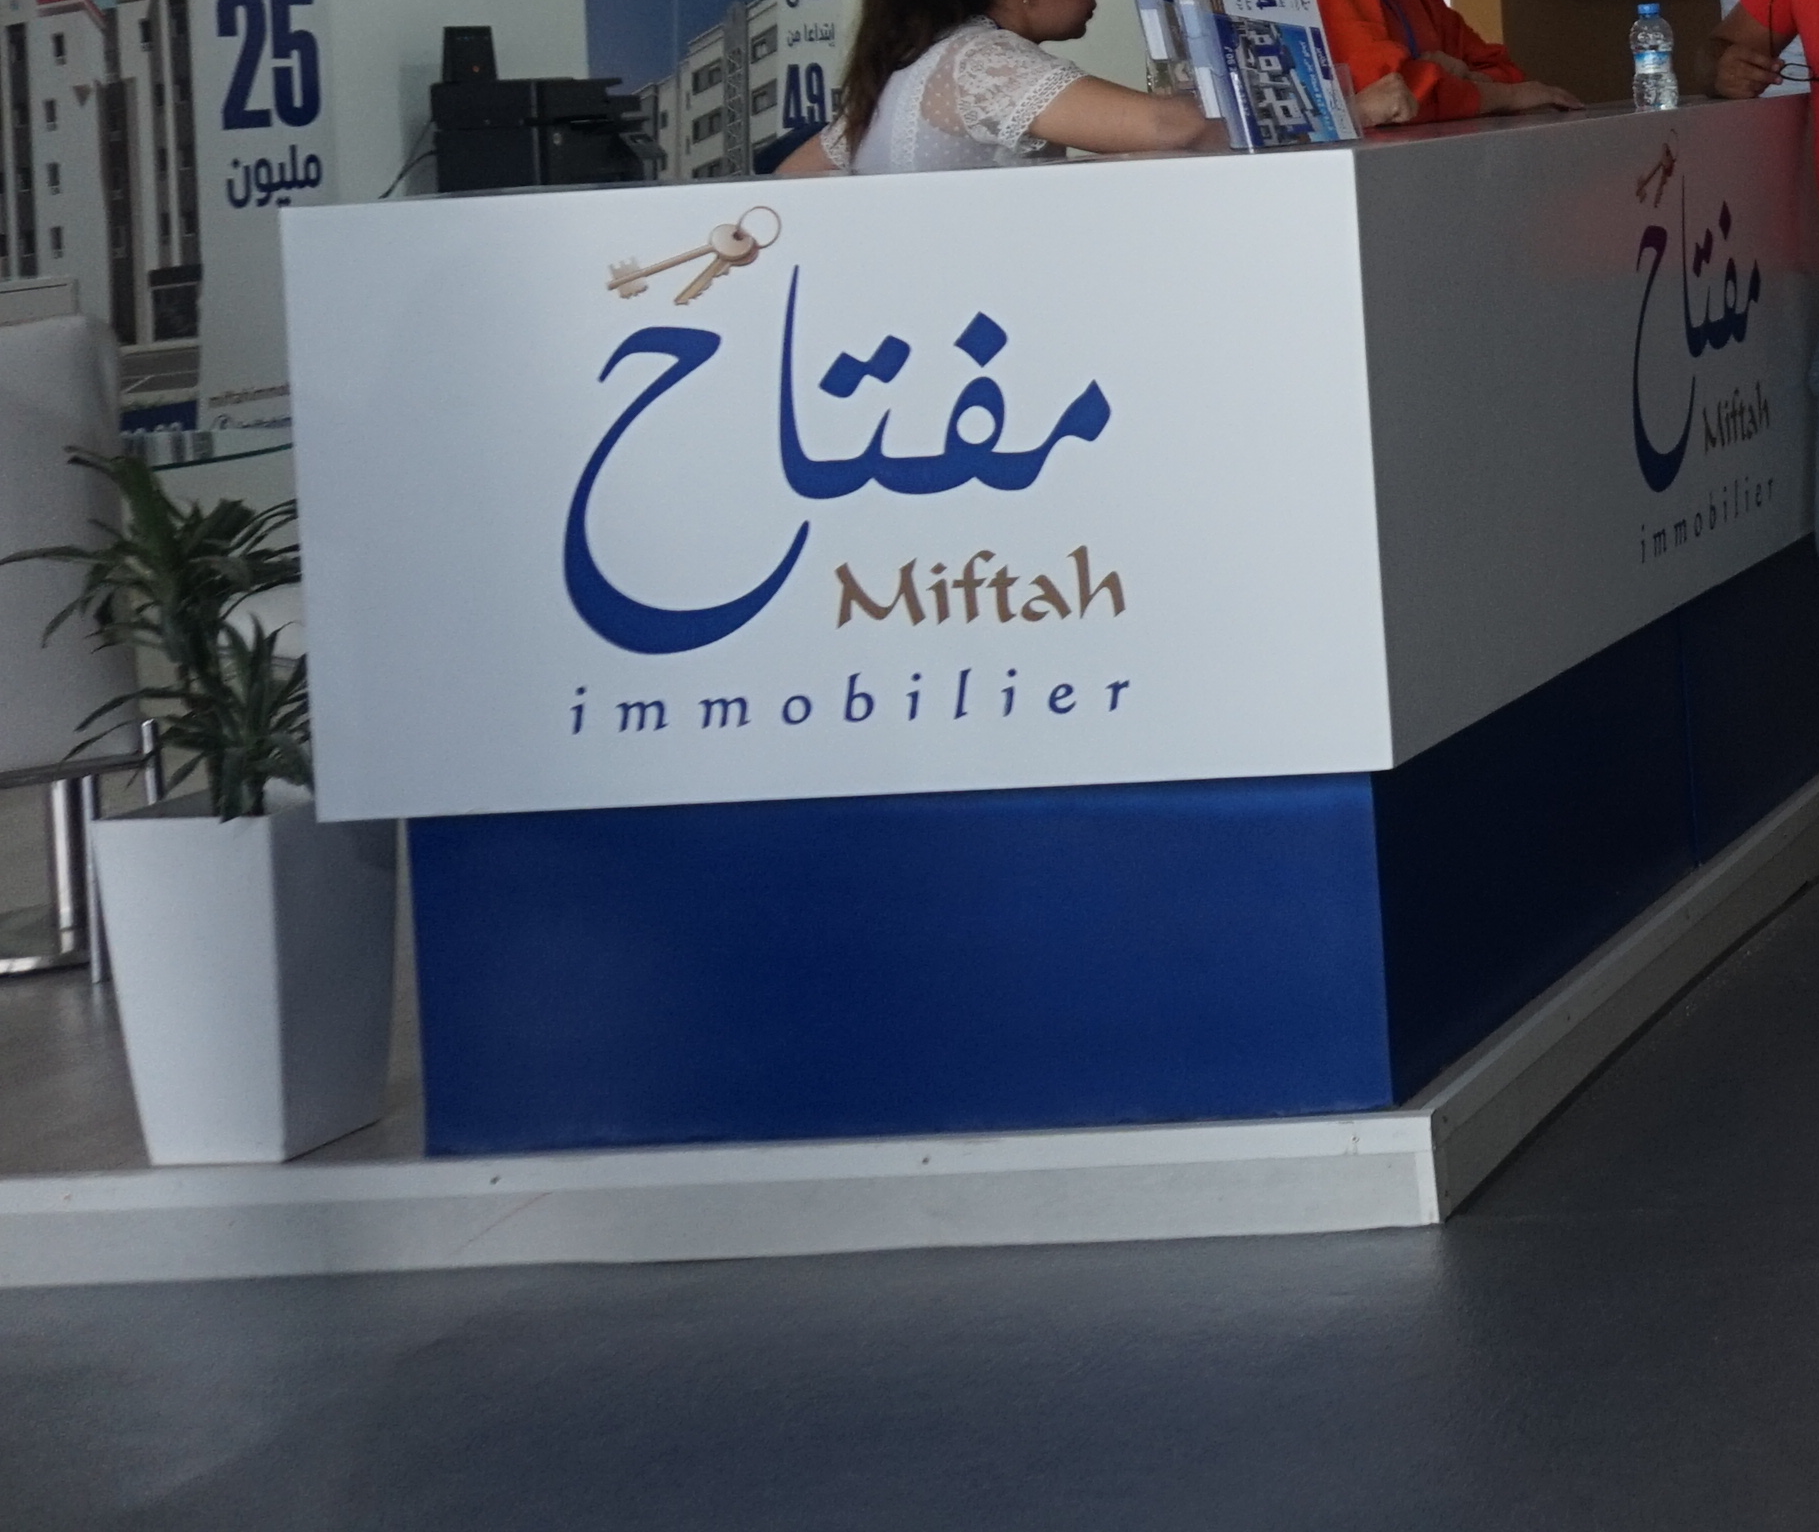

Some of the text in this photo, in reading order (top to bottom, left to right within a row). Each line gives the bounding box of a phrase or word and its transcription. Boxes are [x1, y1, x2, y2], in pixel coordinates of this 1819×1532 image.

[226, 144, 323, 209] مليون
[1633, 175, 1762, 493] مفتاح
[1703, 380, 1771, 454] Miftah
[564, 265, 1112, 655] مفتاح
[1641, 476, 1775, 564] immobilier
[834, 544, 1126, 629] Miftah
[570, 668, 1131, 736] immobilier
